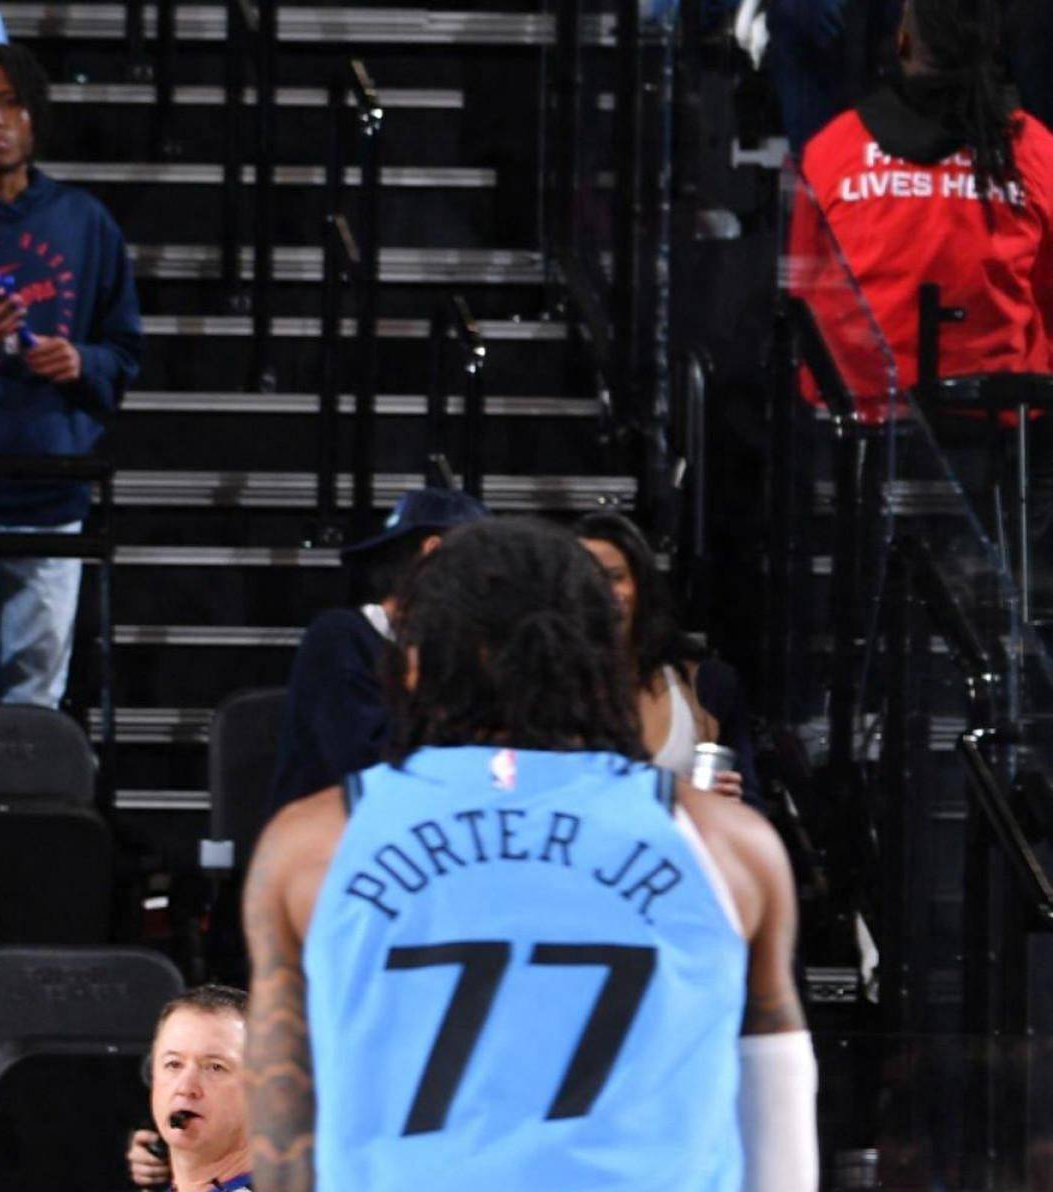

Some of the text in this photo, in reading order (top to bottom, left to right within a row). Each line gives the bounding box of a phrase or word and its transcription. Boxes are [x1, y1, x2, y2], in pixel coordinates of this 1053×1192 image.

[841, 170, 933, 203] LIVES
[346, 808, 583, 920] PORTER
[384, 939, 659, 1138] 77
